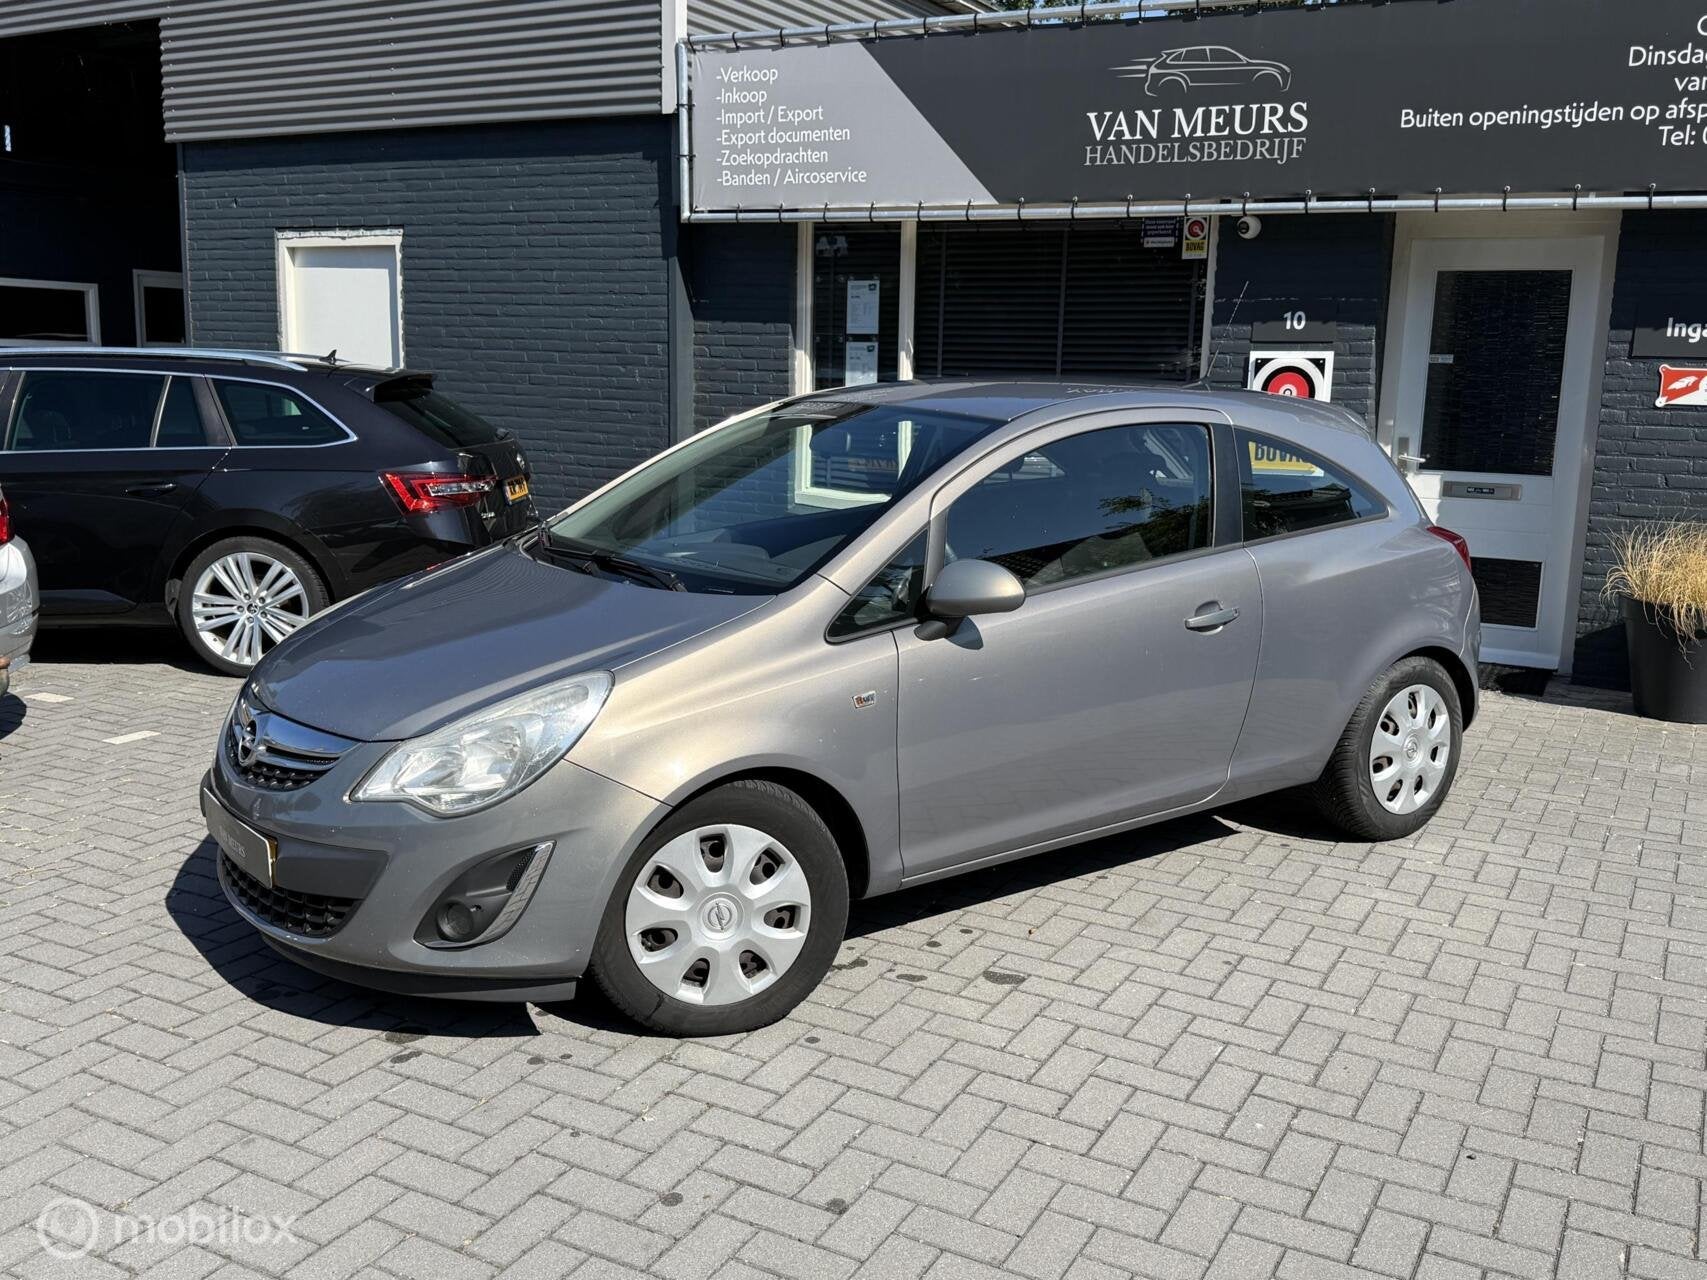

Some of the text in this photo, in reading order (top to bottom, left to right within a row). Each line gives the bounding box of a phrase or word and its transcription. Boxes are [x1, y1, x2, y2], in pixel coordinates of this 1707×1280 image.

[1628, 42, 1707, 67] Dinsda
[716, 66, 778, 83] -Verkoop
[716, 88, 767, 106] -Inkoop
[716, 109, 765, 128] -Import
[778, 105, 823, 127] Export
[1086, 101, 1308, 142] VAN MEURS
[1400, 105, 1463, 128] Buiten
[1469, 101, 1624, 131] openingstijden
[1630, 105, 1660, 125] op
[716, 126, 850, 148] -Export documenten
[1658, 124, 1696, 146] Tel:
[716, 147, 828, 168] -Zoekopdrachten
[1083, 137, 1307, 166] HANDELSBEDRIJF
[716, 171, 770, 186] -Banden
[784, 167, 867, 184] Aircoservice
[1283, 311, 1306, 330] 10
